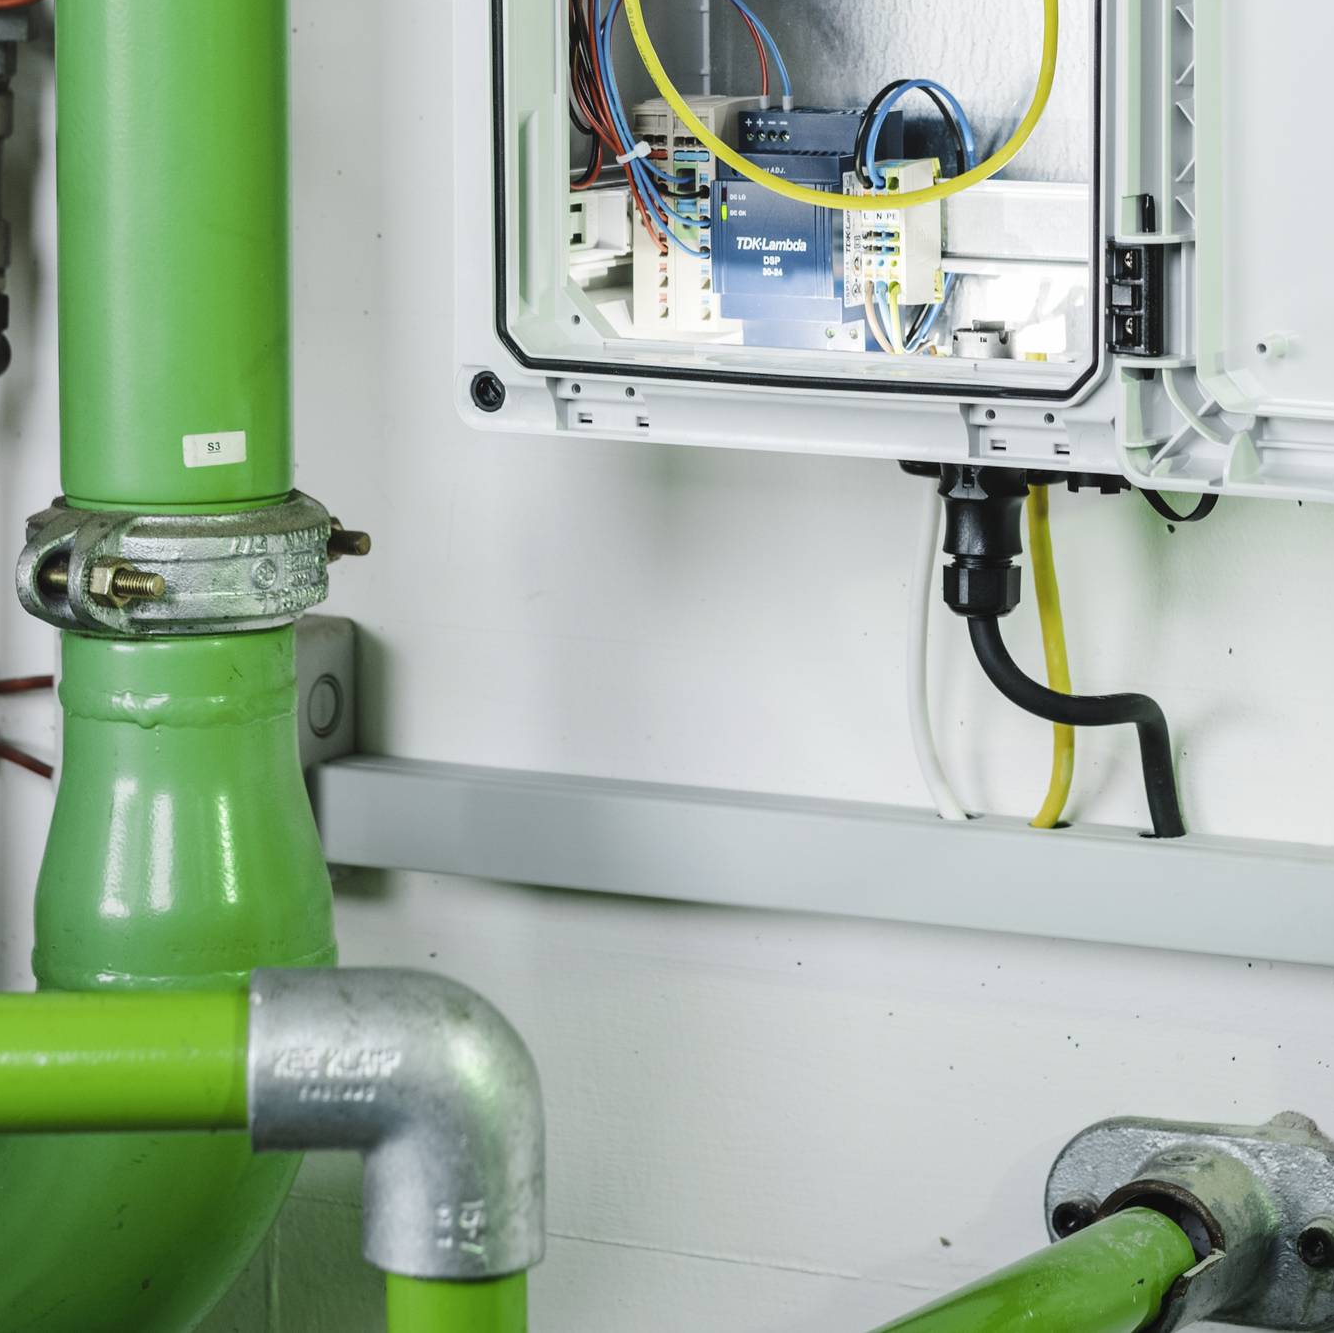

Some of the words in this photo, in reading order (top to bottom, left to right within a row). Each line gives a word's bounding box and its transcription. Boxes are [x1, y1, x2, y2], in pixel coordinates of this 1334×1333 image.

[876, 212, 883, 220] N
[763, 255, 781, 266] DSP
[207, 441, 222, 452] S3
